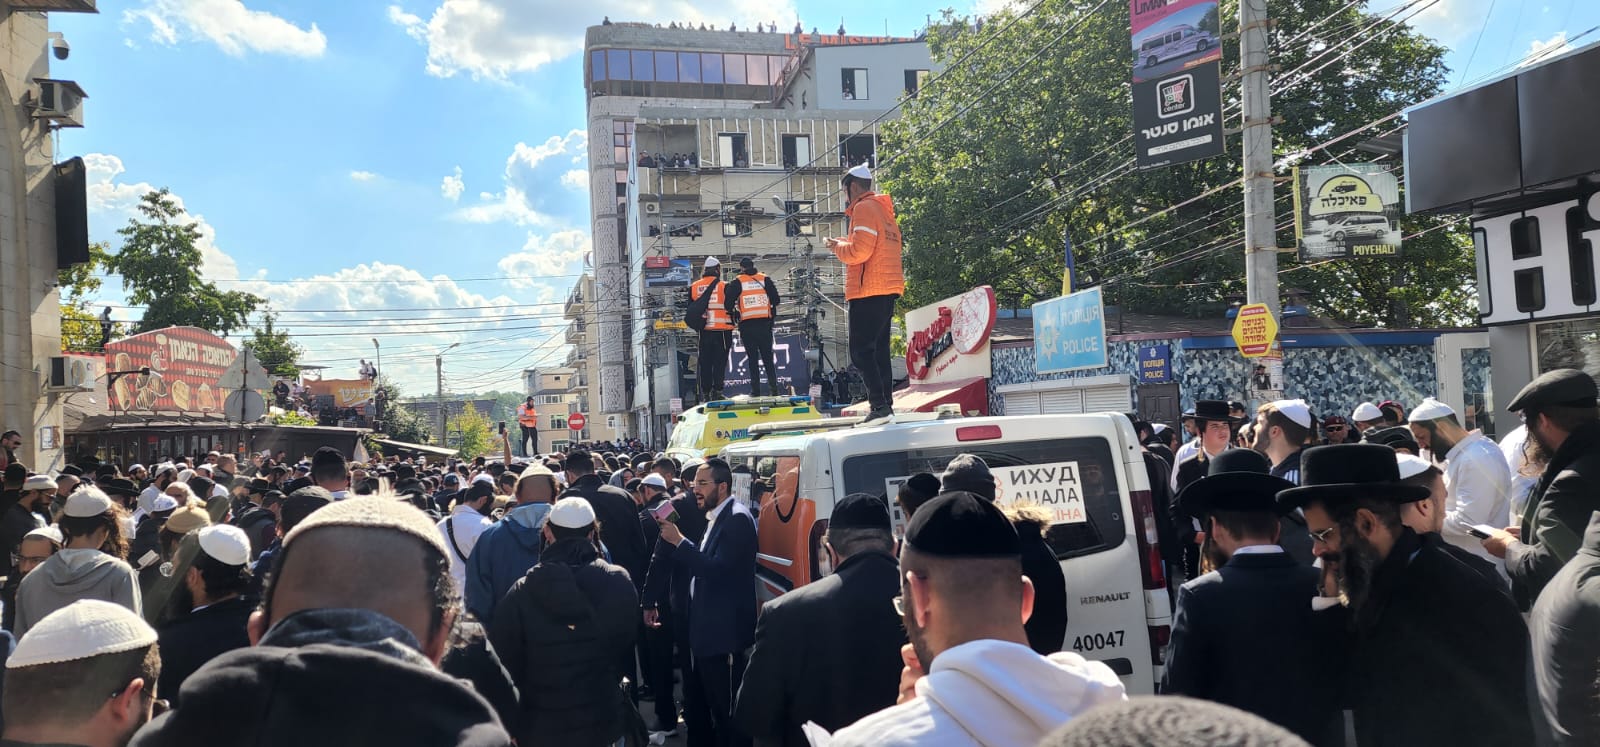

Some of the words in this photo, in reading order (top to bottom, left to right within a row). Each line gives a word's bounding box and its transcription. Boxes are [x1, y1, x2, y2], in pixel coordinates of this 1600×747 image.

[1183, 112, 1215, 131] אומן
[1141, 121, 1179, 139] סנטר
[1321, 193, 1367, 208] פאיכלה
[1353, 244, 1396, 255] POYEHALI
[1061, 304, 1100, 327] ПОЛІЦІЯ
[1242, 317, 1266, 327] הכניסה
[1242, 326, 1266, 335] לכהנים
[1063, 336, 1099, 355] POLICE
[1143, 358, 1165, 369] ПОЛІЦІЯ
[1144, 370, 1165, 379] POLICE
[1010, 466, 1077, 486] ИХУД
[1080, 592, 1131, 605] RENAULT
[1073, 630, 1125, 652] 40047
